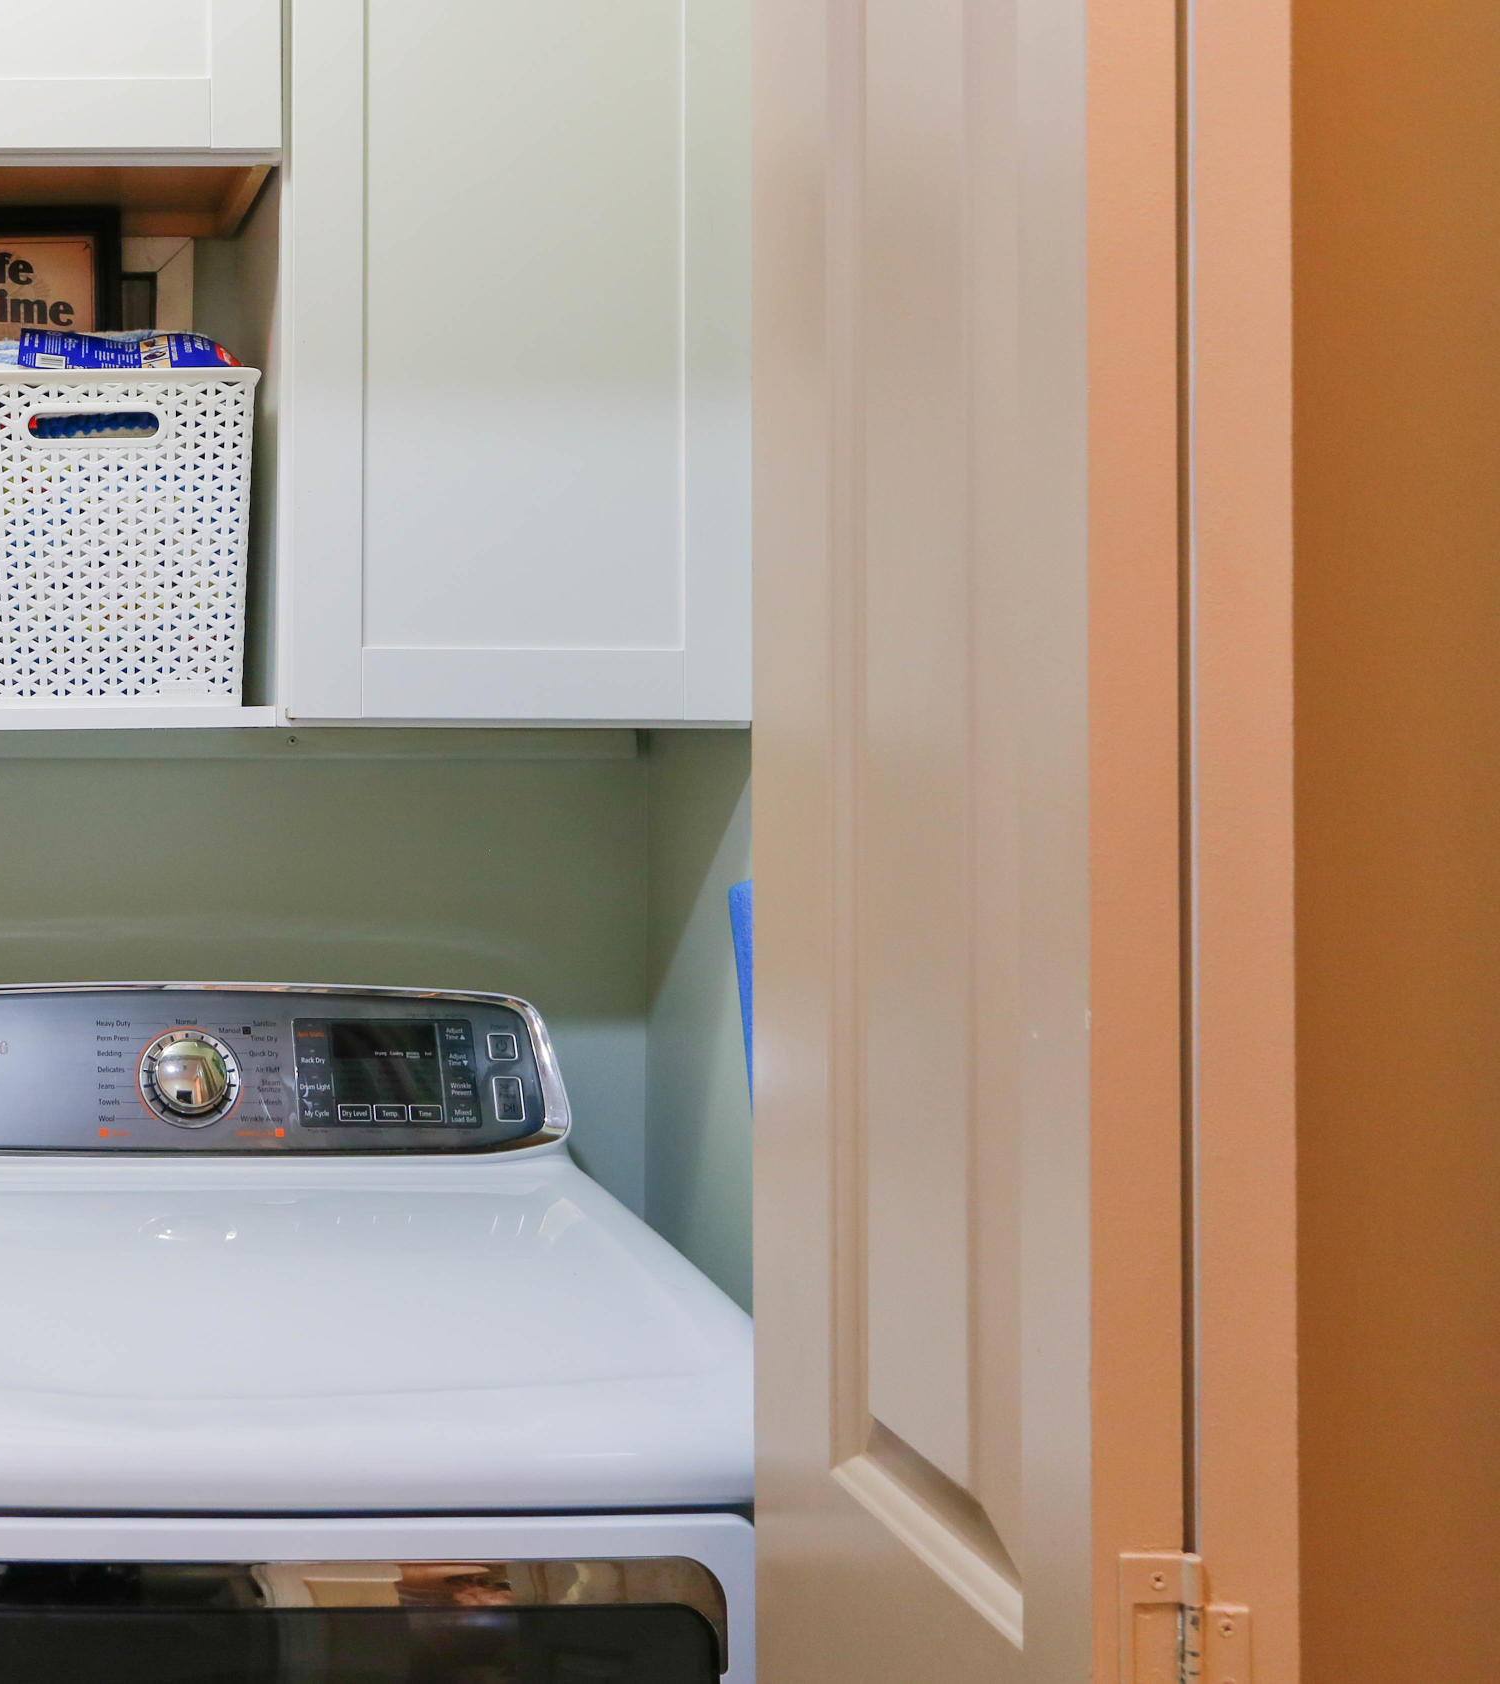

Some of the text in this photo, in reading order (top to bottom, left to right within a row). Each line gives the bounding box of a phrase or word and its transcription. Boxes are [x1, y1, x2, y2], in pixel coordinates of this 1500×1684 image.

[266, 1035, 278, 1043] Dry
[97, 1050, 122, 1058] Bedding
[267, 1050, 279, 1058] Dry
[315, 1057, 326, 1065] Dry
[316, 1083, 331, 1091] Light
[304, 1110, 330, 1118] My Cycle
[342, 1109, 368, 1118] Dry Level
